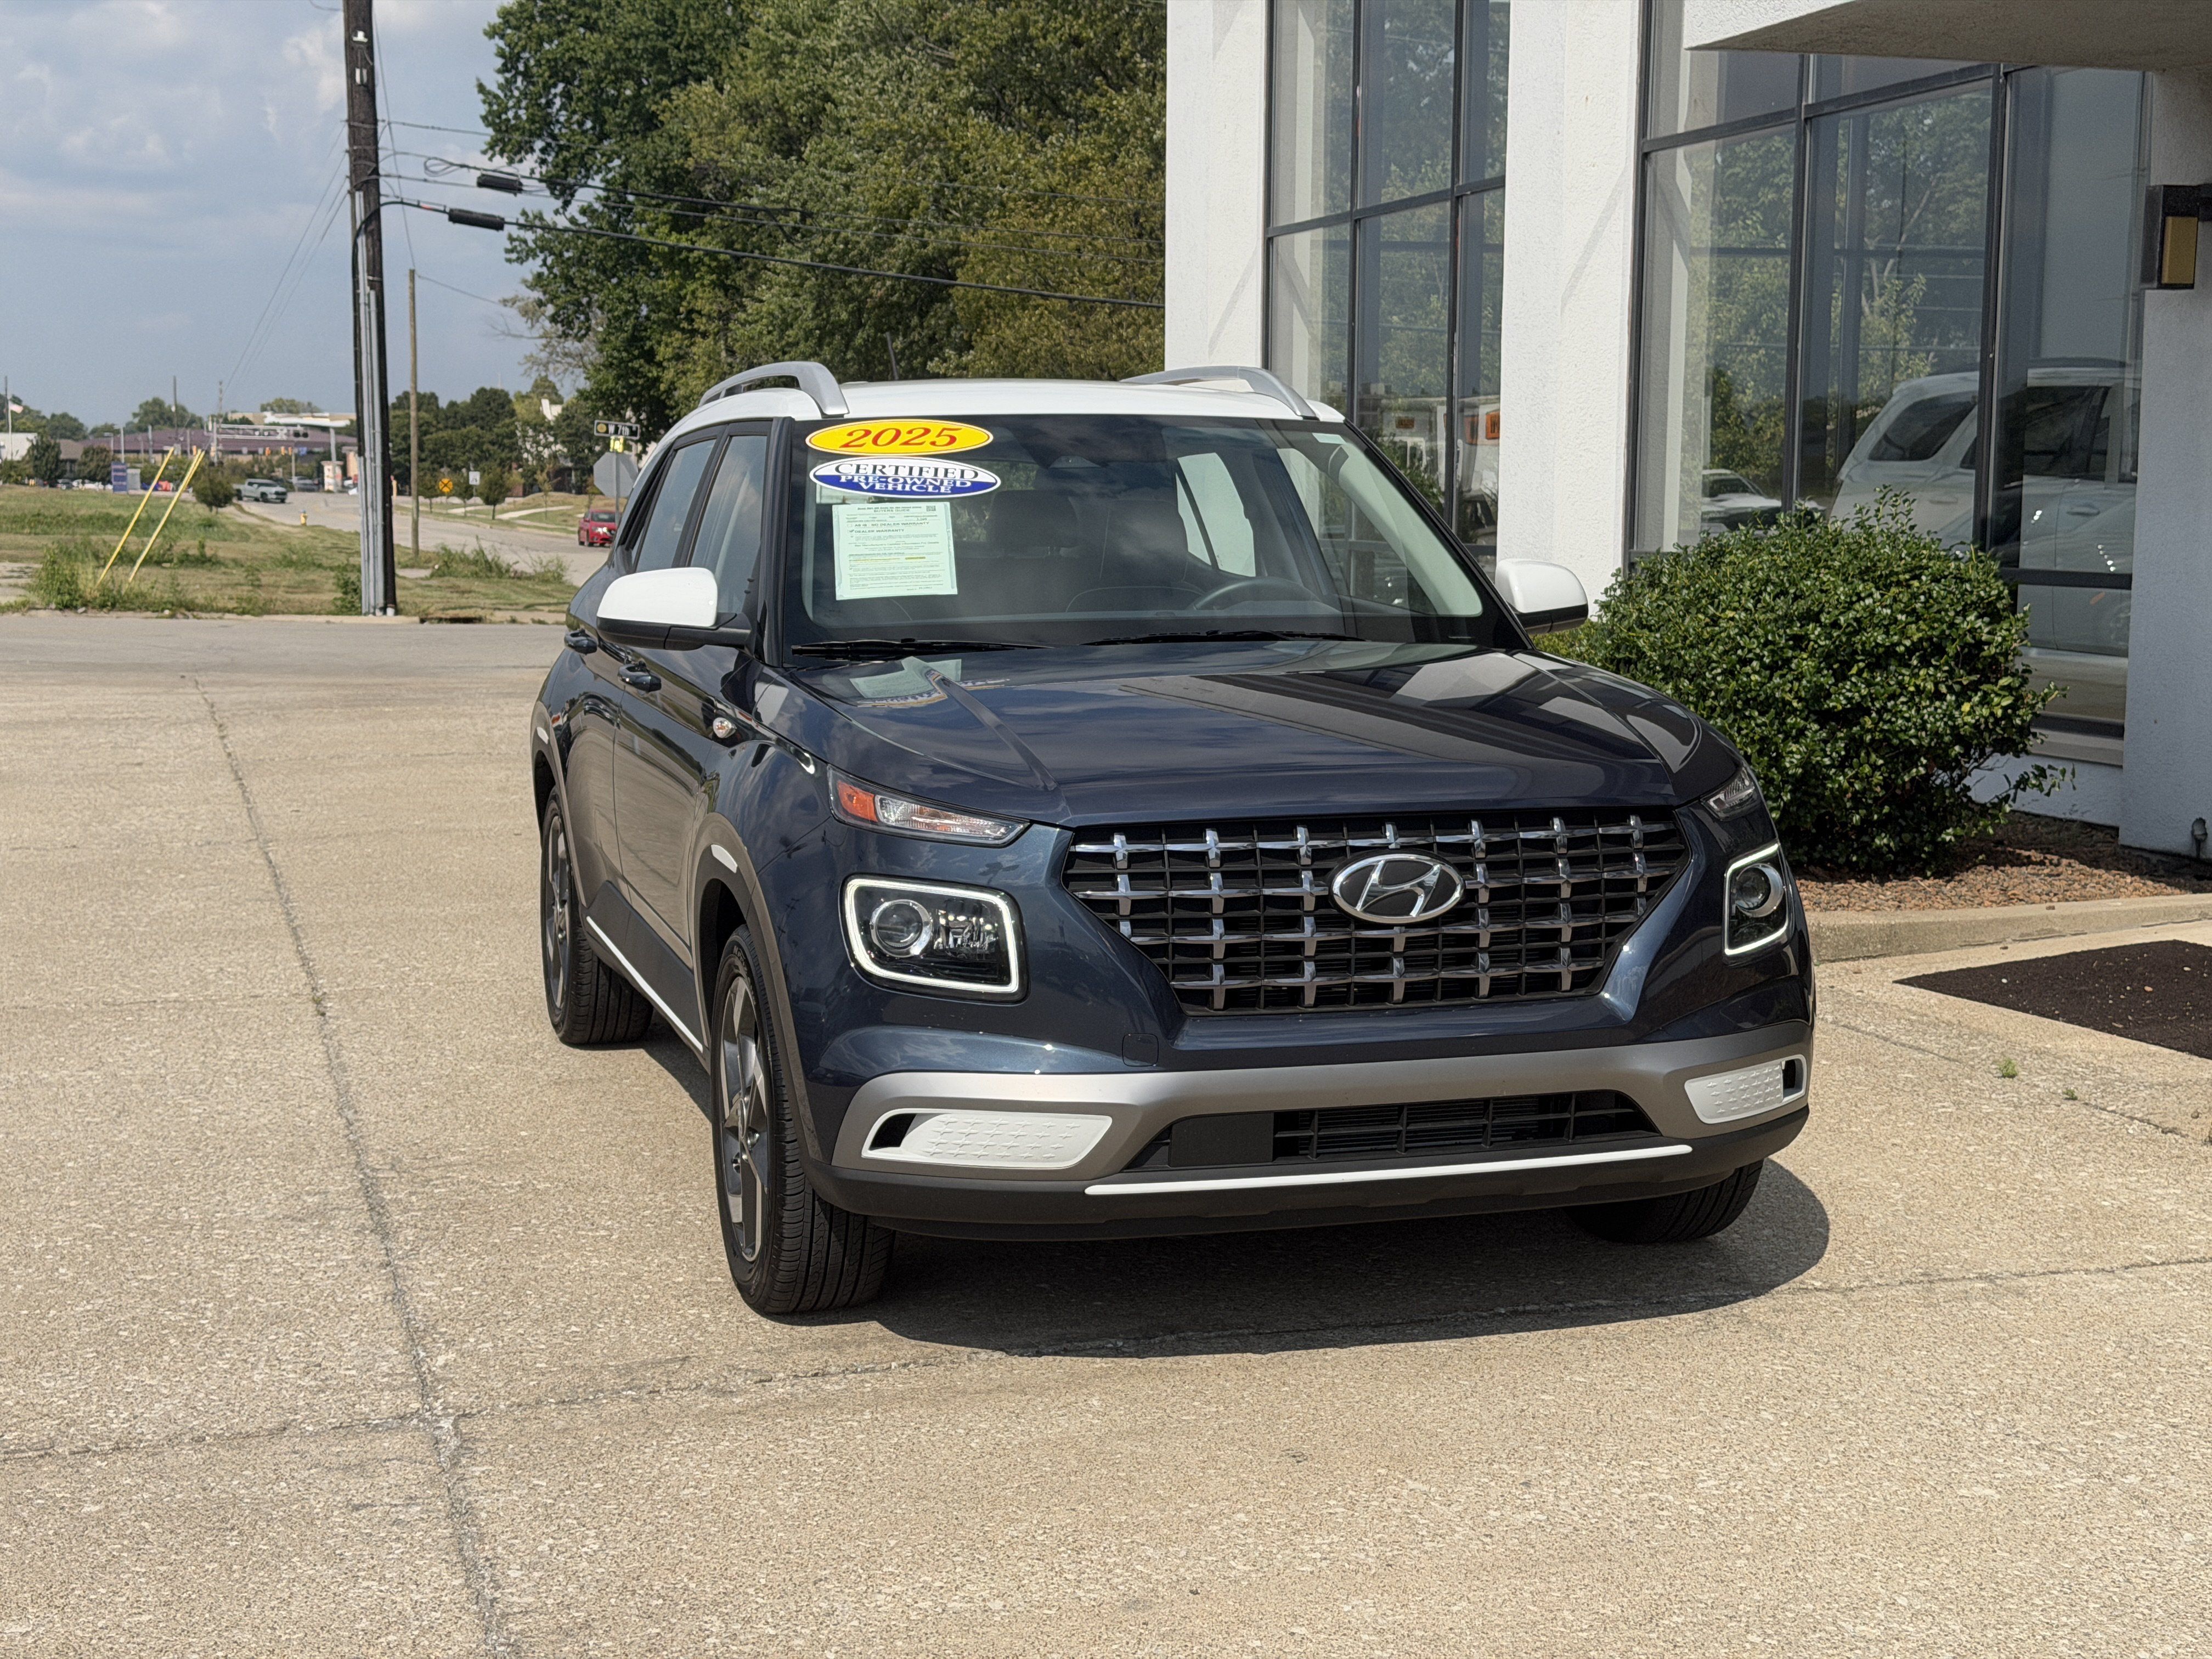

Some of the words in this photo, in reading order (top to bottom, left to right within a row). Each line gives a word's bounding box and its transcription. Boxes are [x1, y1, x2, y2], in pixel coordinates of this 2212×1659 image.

[608, 424, 614, 435] W
[618, 425, 629, 436] 7th
[839, 427, 962, 448] 2025
[835, 464, 978, 479] CERTIFIED
[840, 475, 972, 488] PRE-OWNED
[859, 482, 951, 493] VEHICLE
